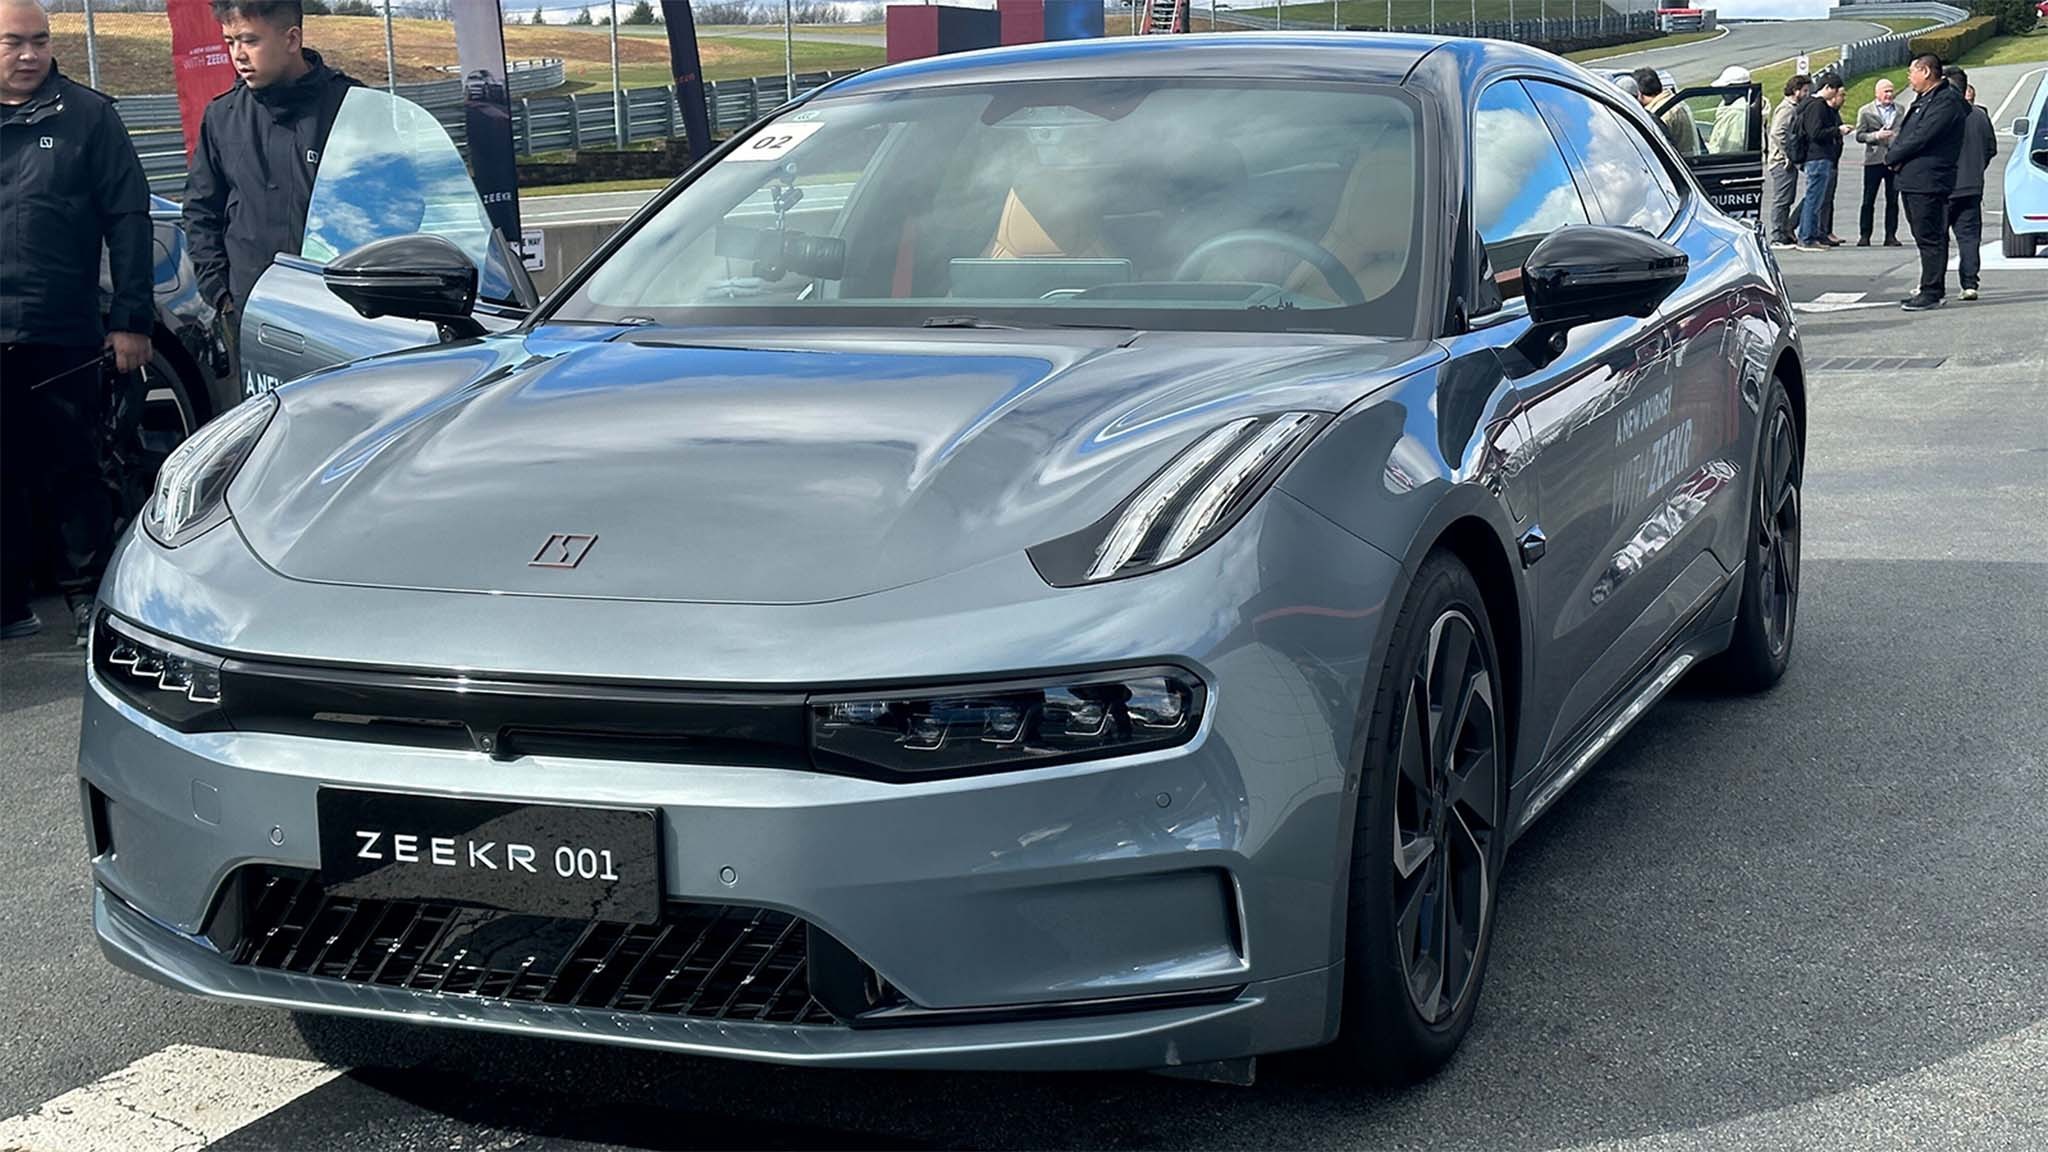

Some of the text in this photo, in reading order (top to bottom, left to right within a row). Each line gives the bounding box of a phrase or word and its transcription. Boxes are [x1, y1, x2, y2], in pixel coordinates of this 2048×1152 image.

[752, 136, 793, 149] 02
[246, 370, 256, 395] A
[1615, 385, 1673, 448] A NEW JOURNEY
[1610, 418, 1693, 527] WITH ZEEKR
[355, 830, 619, 881] ZEEKR 001
